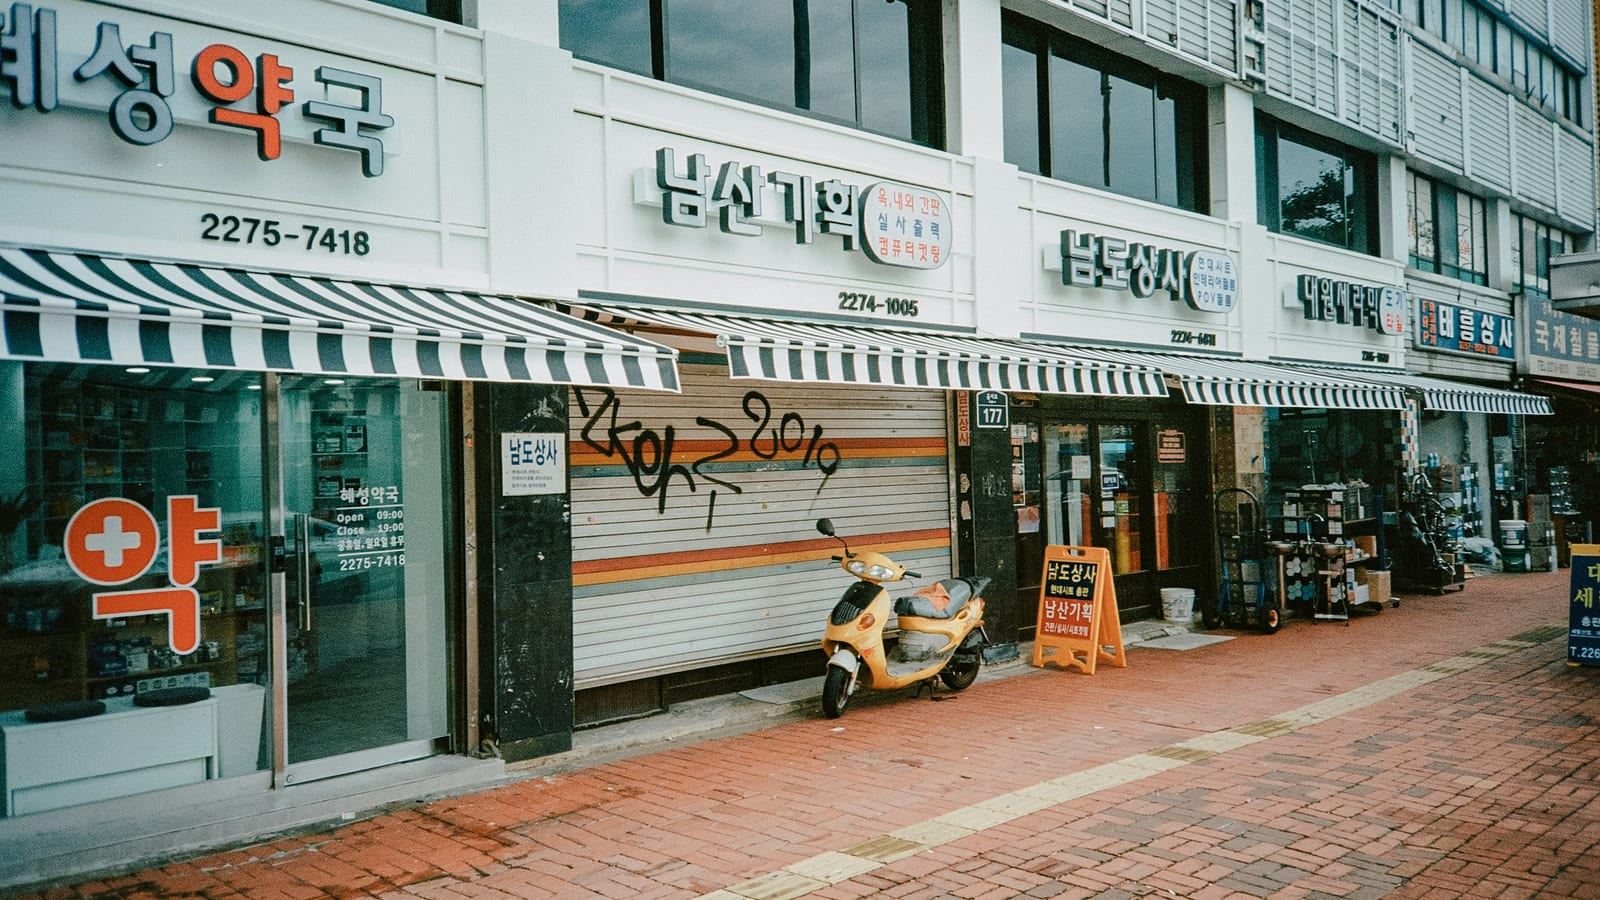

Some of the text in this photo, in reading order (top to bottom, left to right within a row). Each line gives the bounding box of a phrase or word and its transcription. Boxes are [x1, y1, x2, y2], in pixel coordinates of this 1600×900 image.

[656, 147, 860, 251] 남산기획
[920, 196, 940, 217] 간판
[200, 213, 371, 256] 2275-7418
[1060, 229, 1185, 301] 남도상사
[838, 291, 919, 317] 2274-1005
[983, 408, 1002, 423] 177
[509, 438, 557, 466] 남도상사
[340, 485, 399, 505] 혜성약국
[336, 510, 403, 524] Open 09:00
[336, 522, 404, 536] Close 19:00
[389, 535, 405, 547] 휴무
[340, 554, 406, 571] 2275-7418
[1047, 562, 1097, 583] 남도상사
[63, 494, 222, 655] 약
[1050, 584, 1089, 597] 현대시트 총판
[1044, 600, 1094, 623] 남산기획
